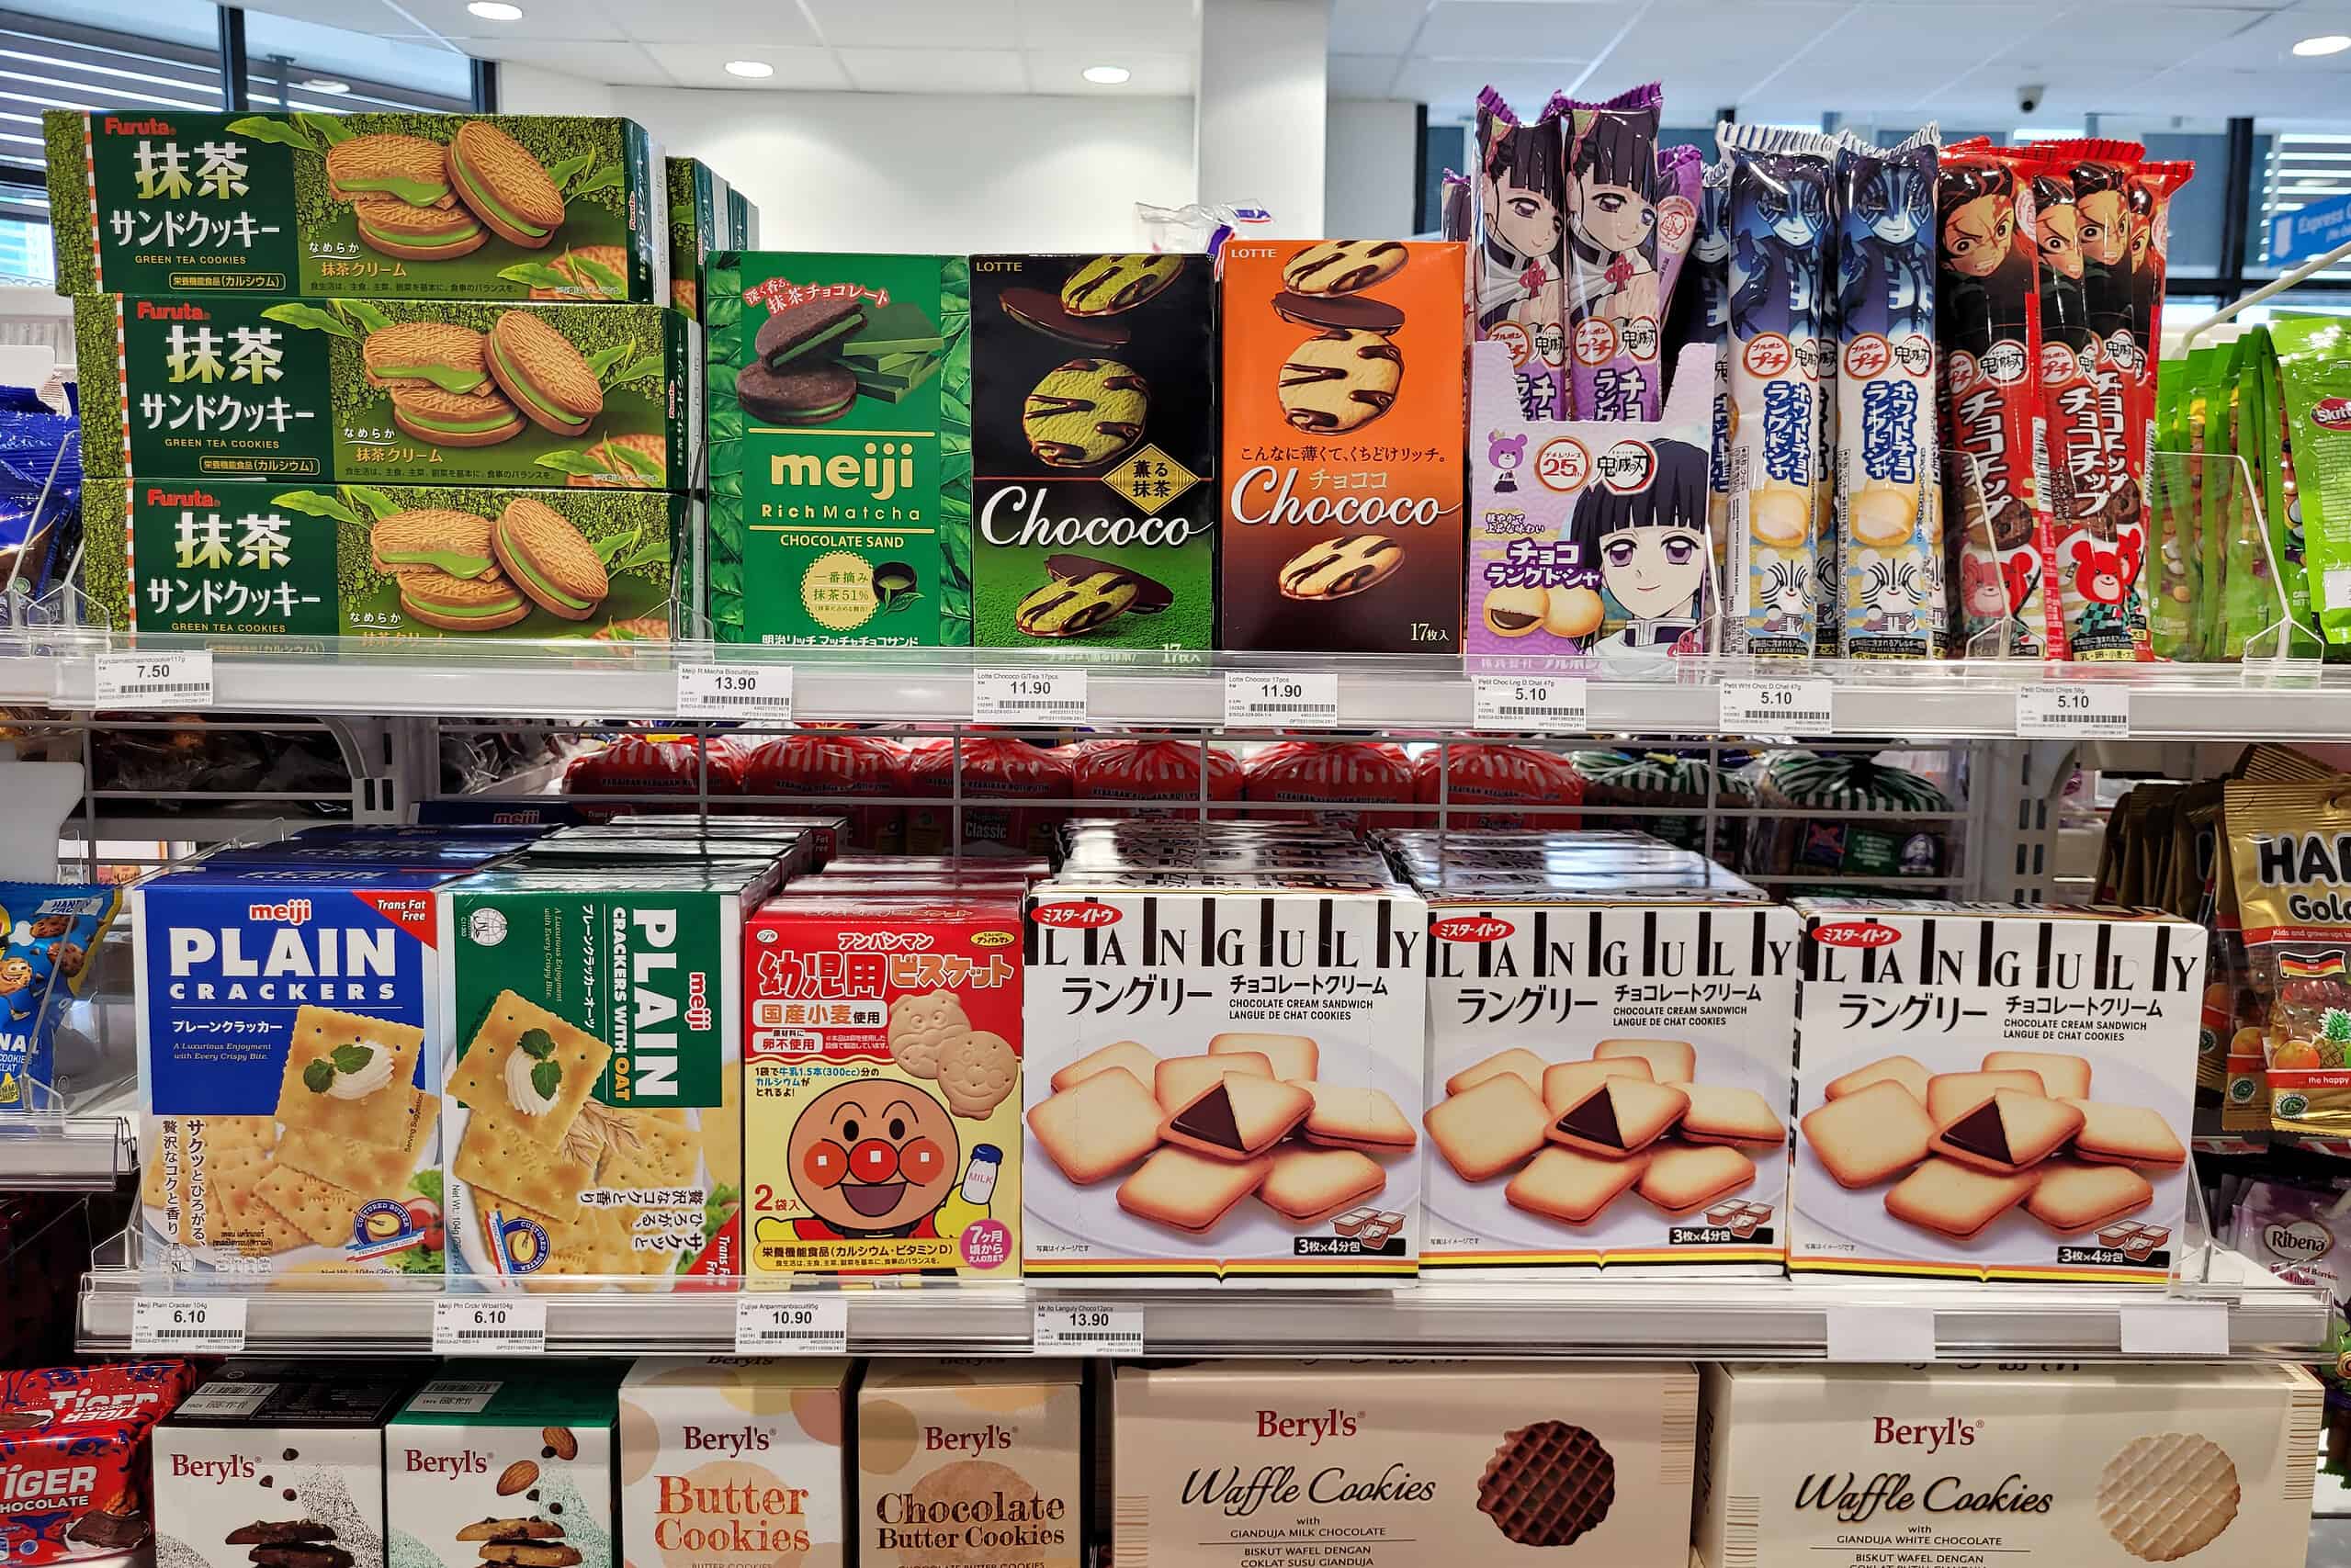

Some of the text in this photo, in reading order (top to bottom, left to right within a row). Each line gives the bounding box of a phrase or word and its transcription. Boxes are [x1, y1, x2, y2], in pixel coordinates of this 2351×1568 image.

[105, 117, 169, 135] Furuta
[133, 141, 250, 199] 抹茶
[110, 210, 280, 247] サンドクッキー
[310, 242, 359, 254] なめらか
[1231, 249, 1277, 258] LOTTE
[135, 255, 246, 265] GREEN TEA COOKIES
[976, 262, 1022, 272] LOTTE
[322, 262, 406, 277] 抹茶クリーム
[768, 284, 889, 313] 抹茶チョコレート
[138, 301, 204, 321] Furuta
[165, 325, 284, 384] 抹茶
[140, 393, 314, 433] サンドクッキー
[345, 428, 395, 439] なめらか
[165, 438, 280, 449] GREEN TEA COOKIES
[2059, 387, 2110, 516] チョコチップ
[356, 447, 443, 463] 抹茶クリーム
[771, 443, 913, 501] meiji
[1133, 459, 1170, 479] 薫る
[1592, 453, 1649, 484] 鬼滅の刃
[1309, 468, 1388, 490] チョココ
[1133, 479, 1171, 498] 抹茶
[1230, 465, 1463, 525] Chococo
[147, 489, 214, 507] Furuta
[762, 504, 920, 521] Rich Matcha
[980, 485, 1215, 546] Chococo
[175, 512, 291, 570] 抹茶
[781, 535, 904, 548] CHOCOLATE SAND
[1509, 540, 1580, 565] チョコ
[1486, 565, 1600, 587] ラングドシャ
[147, 579, 321, 616] サンドクッキー
[813, 588, 869, 601] 抹茶51%
[350, 612, 401, 624] なめらか
[172, 622, 286, 633] GREEN TEA COOKIES
[1410, 623, 1450, 641] 17枚入
[137, 664, 170, 678] 7.50
[715, 677, 756, 691] 13.90
[1010, 682, 1051, 694] 11.90
[1261, 685, 1302, 698] 11.90
[1515, 688, 1546, 701] 5.10
[1760, 692, 1792, 705] 5.10
[2058, 695, 2089, 708] 5.10
[250, 899, 311, 925] meiji
[378, 900, 425, 910] Trans Fat
[402, 911, 425, 921] Free
[1042, 908, 1115, 924] ミスターイトウ
[1439, 922, 1509, 938] ミスターイトウ
[1821, 926, 1894, 943] ミスターイトウ
[838, 932, 934, 951] アンパンマン
[169, 928, 396, 976] PLAIN
[757, 950, 1014, 998] 幼児用 ビスケット
[169, 983, 395, 999] CRACKERS
[1062, 974, 1388, 1016] ラングリー チョコレートクリーム
[613, 907, 630, 1100] CRACKERS WITH OAT
[633, 908, 678, 1096] PLAIN
[685, 972, 712, 1031] meiji
[1229, 998, 1373, 1010] CHOCOLATE CREAM SANDWICH
[1457, 983, 1762, 1025] ラングリー チョコレートクリーム
[762, 1004, 880, 1025] 国産小麦使用
[1229, 1010, 1351, 1021] LANGUE DE CHAT COOKIES
[1613, 1006, 1747, 1016] CHOCOLATE CREAM SANDWICH
[1838, 992, 2164, 1033] ラングリー チョコレートクリーム
[172, 1021, 283, 1033] プレーンクラッカー
[1612, 1016, 1726, 1028] LANGUE DE CHAT COOKIES
[2004, 1019, 2147, 1032] CHOCOLATE CREAM SANDWICH
[2003, 1030, 2125, 1042] LANGUE DE CHAT COOKIES
[226, 1043, 271, 1052] Enjoyment
[195, 1053, 247, 1062] Every Crispy
[755, 1077, 810, 1087] カルシウムが
[2308, 1075, 2349, 1088] the happy
[163, 1120, 182, 1235] 贅沢なコクと香り
[968, 1170, 993, 1184] MILK
[754, 1184, 801, 1212] 2袋入
[2272, 1230, 2326, 1252] Ribena
[718, 1235, 731, 1266] Trans
[174, 1310, 206, 1324] 6.10
[474, 1311, 506, 1324] 6.10
[772, 1312, 812, 1324] 10.90
[1069, 1314, 1110, 1326] 13.90
[1255, 1409, 1358, 1446] Beryl's
[1873, 1416, 1976, 1454] Beryl's
[684, 1426, 770, 1458] Beryl's
[924, 1426, 1012, 1458] Beryl's
[171, 1453, 255, 1485] Beryl's
[404, 1449, 488, 1480] Beryl's
[653, 1475, 809, 1516] Butter
[1181, 1462, 1437, 1517] Waffle Cookies
[1794, 1472, 2053, 1523] Waffle Cookies
[876, 1490, 1066, 1526] Chocolate
[1296, 1516, 1321, 1526] with
[1908, 1525, 1932, 1534] with
[654, 1518, 810, 1552] Cookies
[876, 1524, 1066, 1551] Butter Cookies
[1230, 1528, 1386, 1539] GIANDUJA MILK CHOCOLATE
[1837, 1535, 2002, 1546] GIANDUJA WHITE CHOCOLATE
[1244, 1545, 1372, 1557] BISKUT WAFEL DENGAN
[1856, 1553, 1984, 1564] BISKUT WAFEL DENGAN
[1240, 1557, 1374, 1568] COKLAT SUSU GIANDUJA
